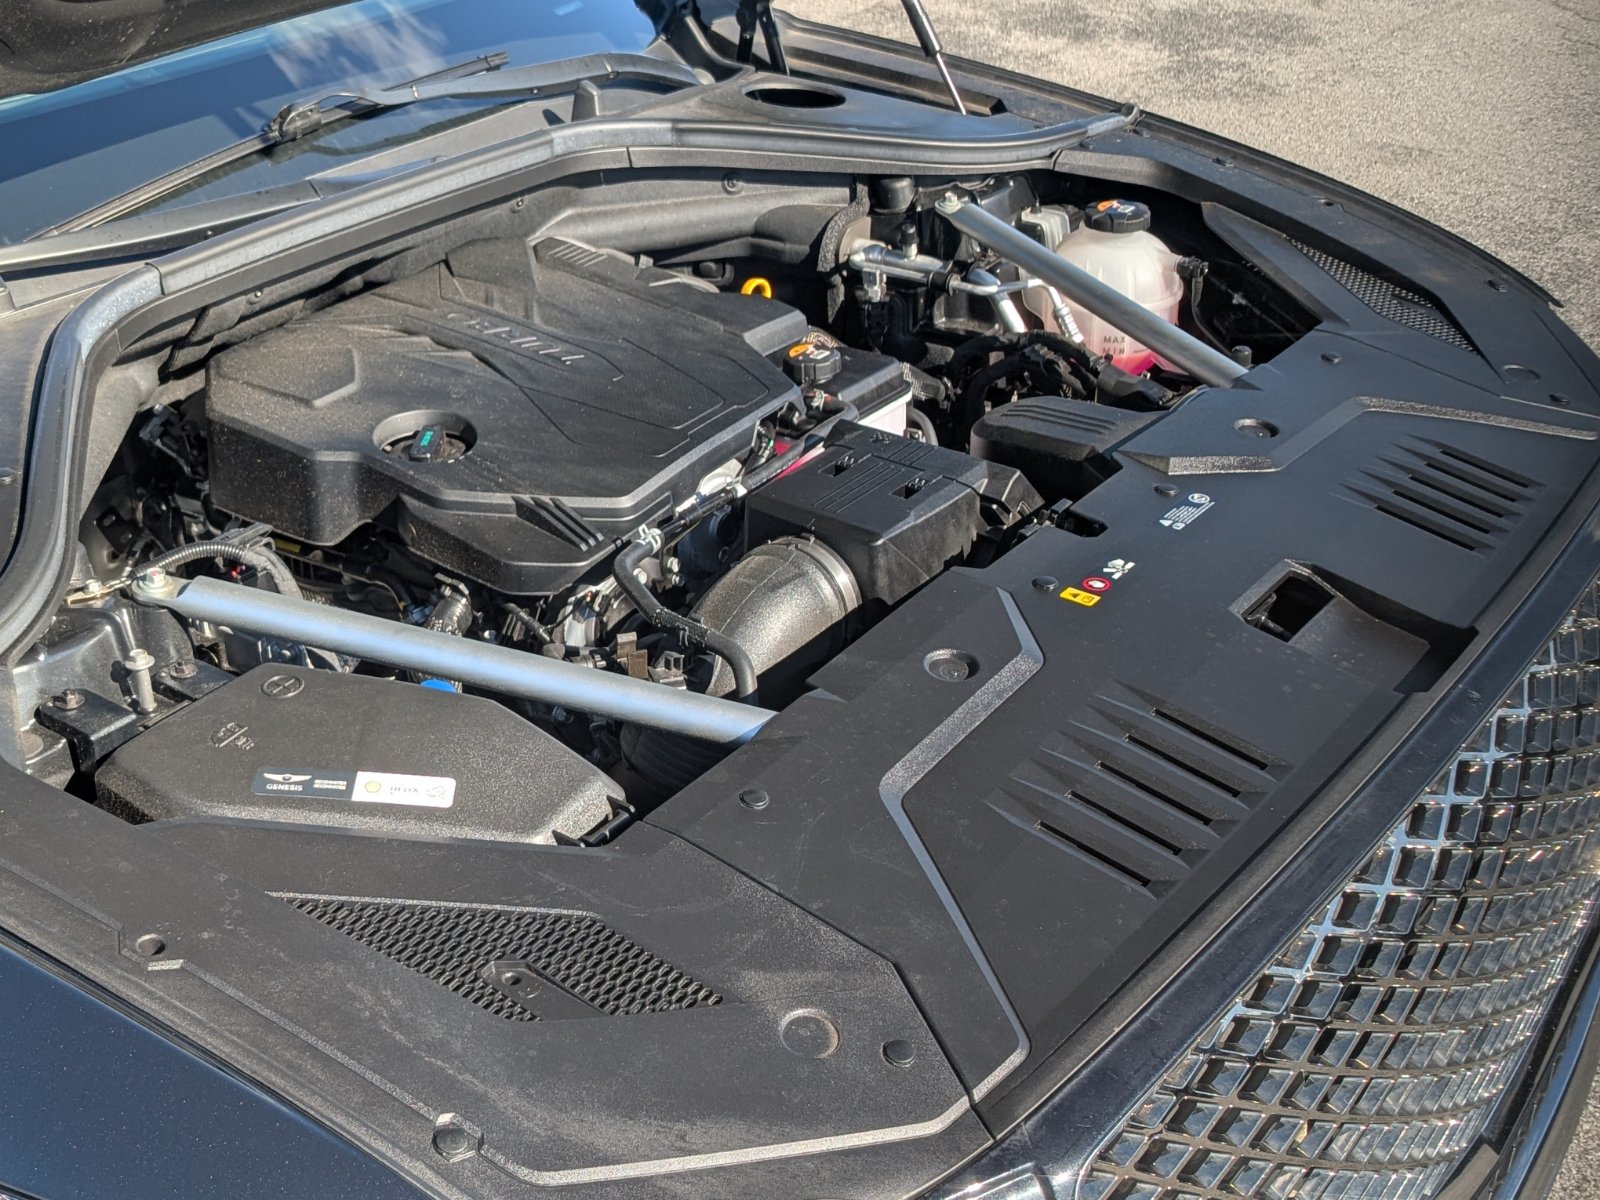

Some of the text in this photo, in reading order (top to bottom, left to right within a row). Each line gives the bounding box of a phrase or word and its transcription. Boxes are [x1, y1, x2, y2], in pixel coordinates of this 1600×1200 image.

[1103, 335, 1126, 344] MAX
[1102, 346, 1125, 355] MIN
[266, 783, 303, 792] GENESIS
